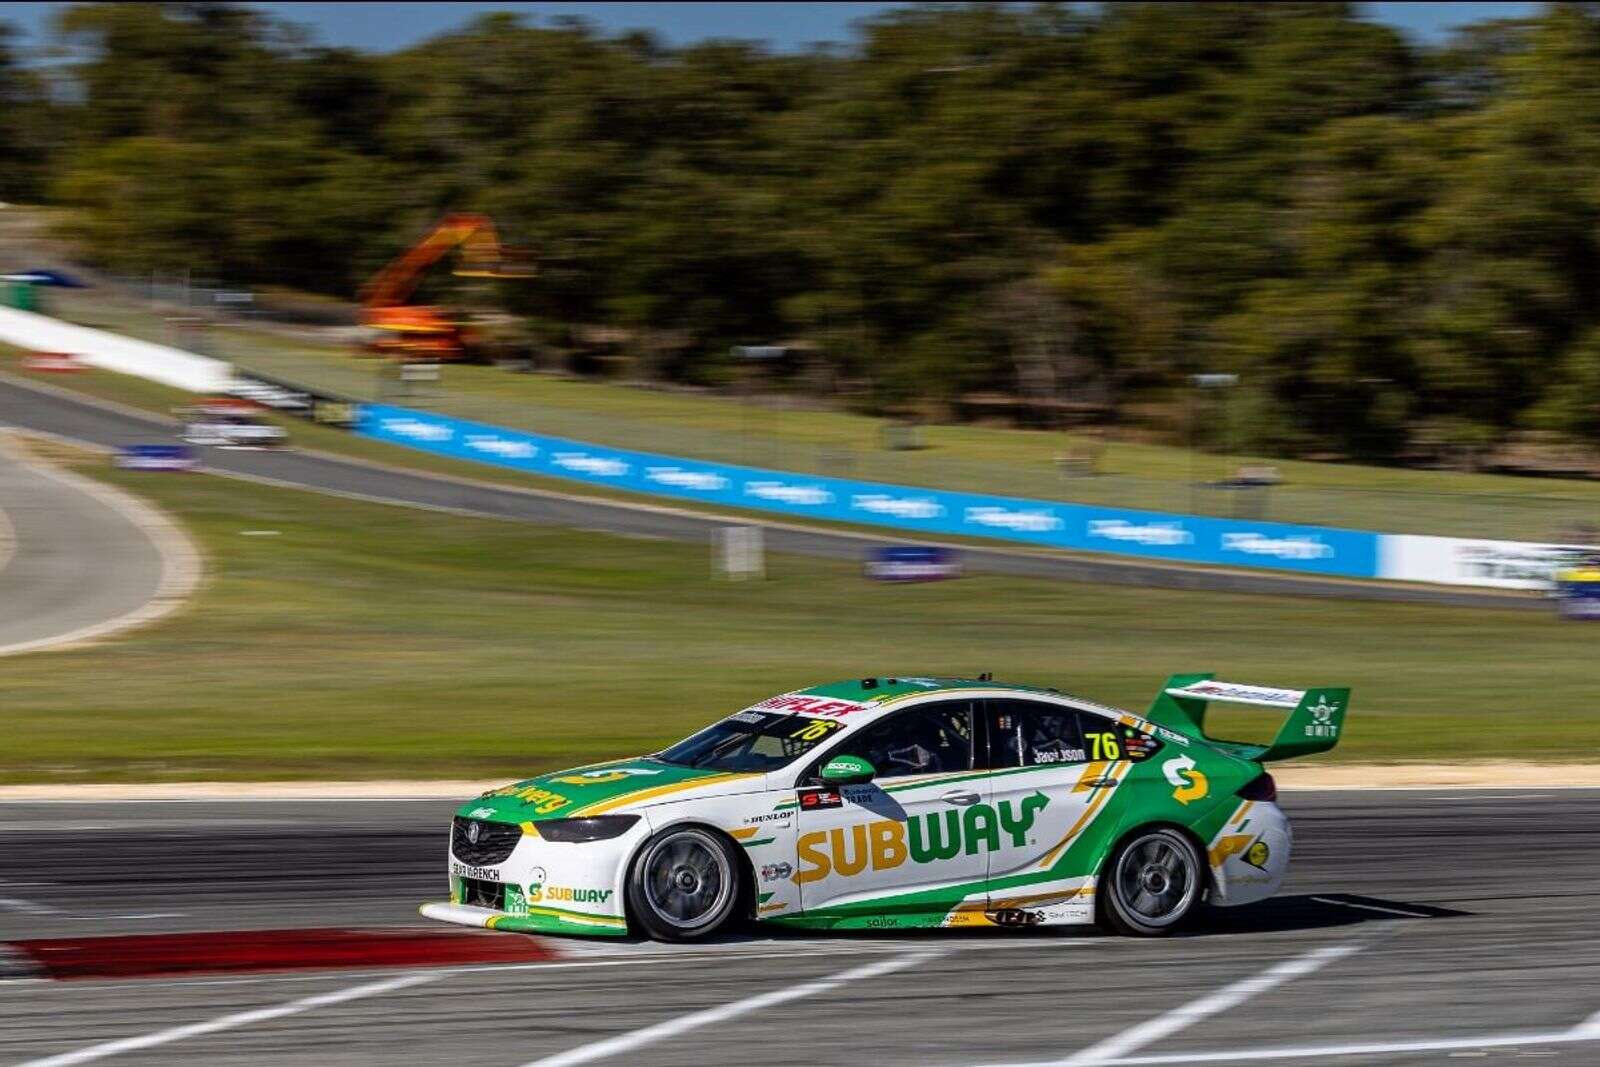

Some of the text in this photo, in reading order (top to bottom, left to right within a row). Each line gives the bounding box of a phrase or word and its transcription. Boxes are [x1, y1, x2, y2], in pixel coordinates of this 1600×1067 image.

[789, 719, 836, 740] 76
[1084, 732, 1120, 760] 76
[750, 811, 795, 824] DUNLOP
[790, 790, 1052, 885] SUBWAY
[546, 886, 614, 903] SUBWAY
